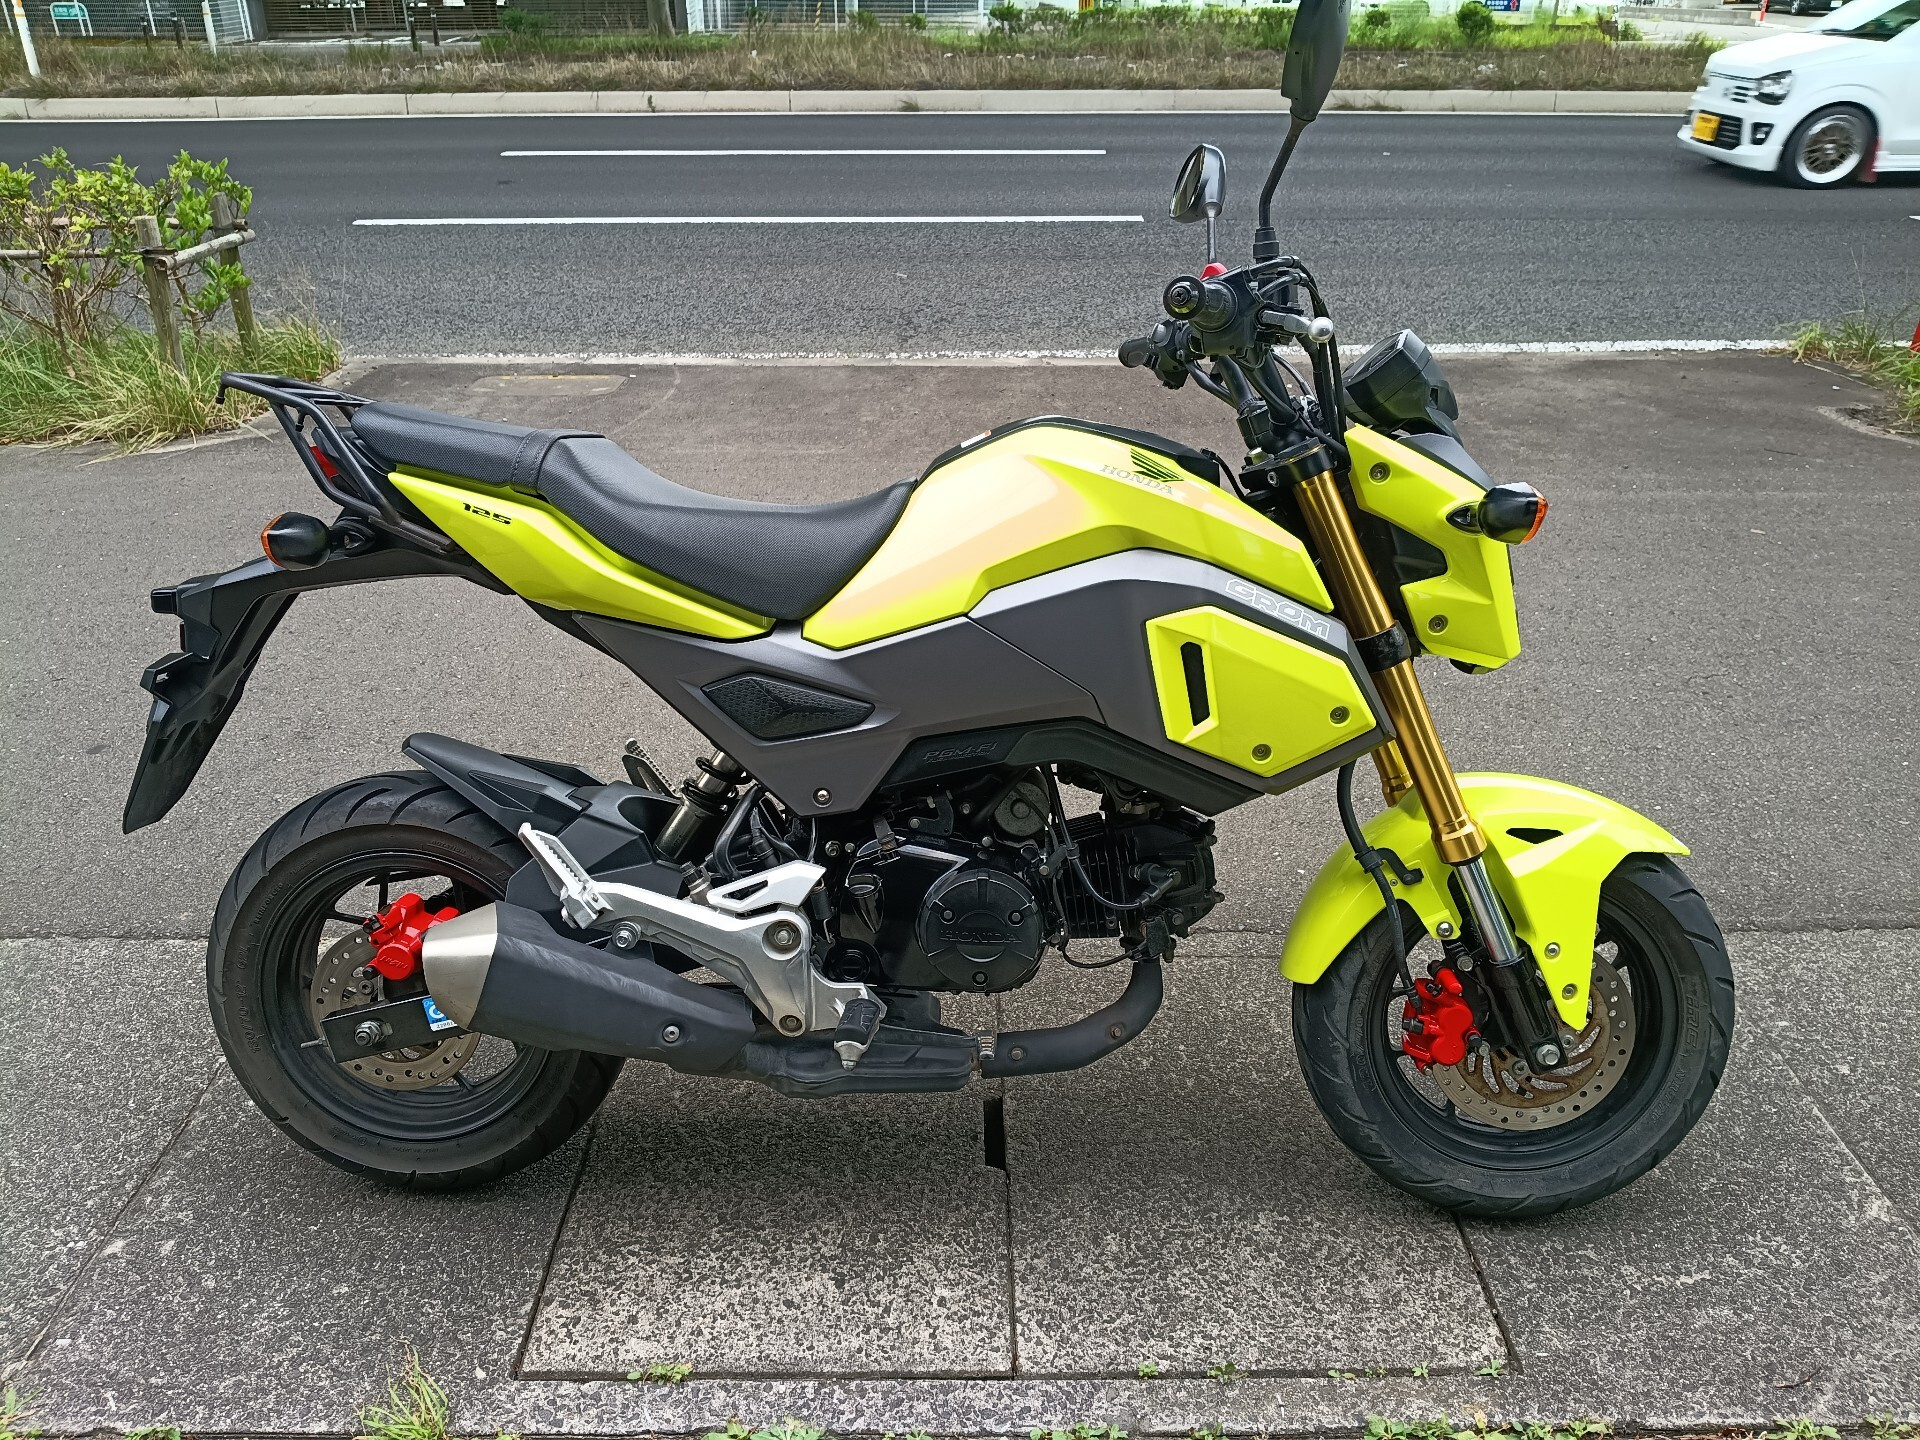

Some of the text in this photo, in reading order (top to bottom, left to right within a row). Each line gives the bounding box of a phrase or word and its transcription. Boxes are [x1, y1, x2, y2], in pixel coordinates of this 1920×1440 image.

[1100, 464, 1173, 495] HONDA
[462, 502, 512, 525] 125
[1225, 579, 1330, 640] GROM
